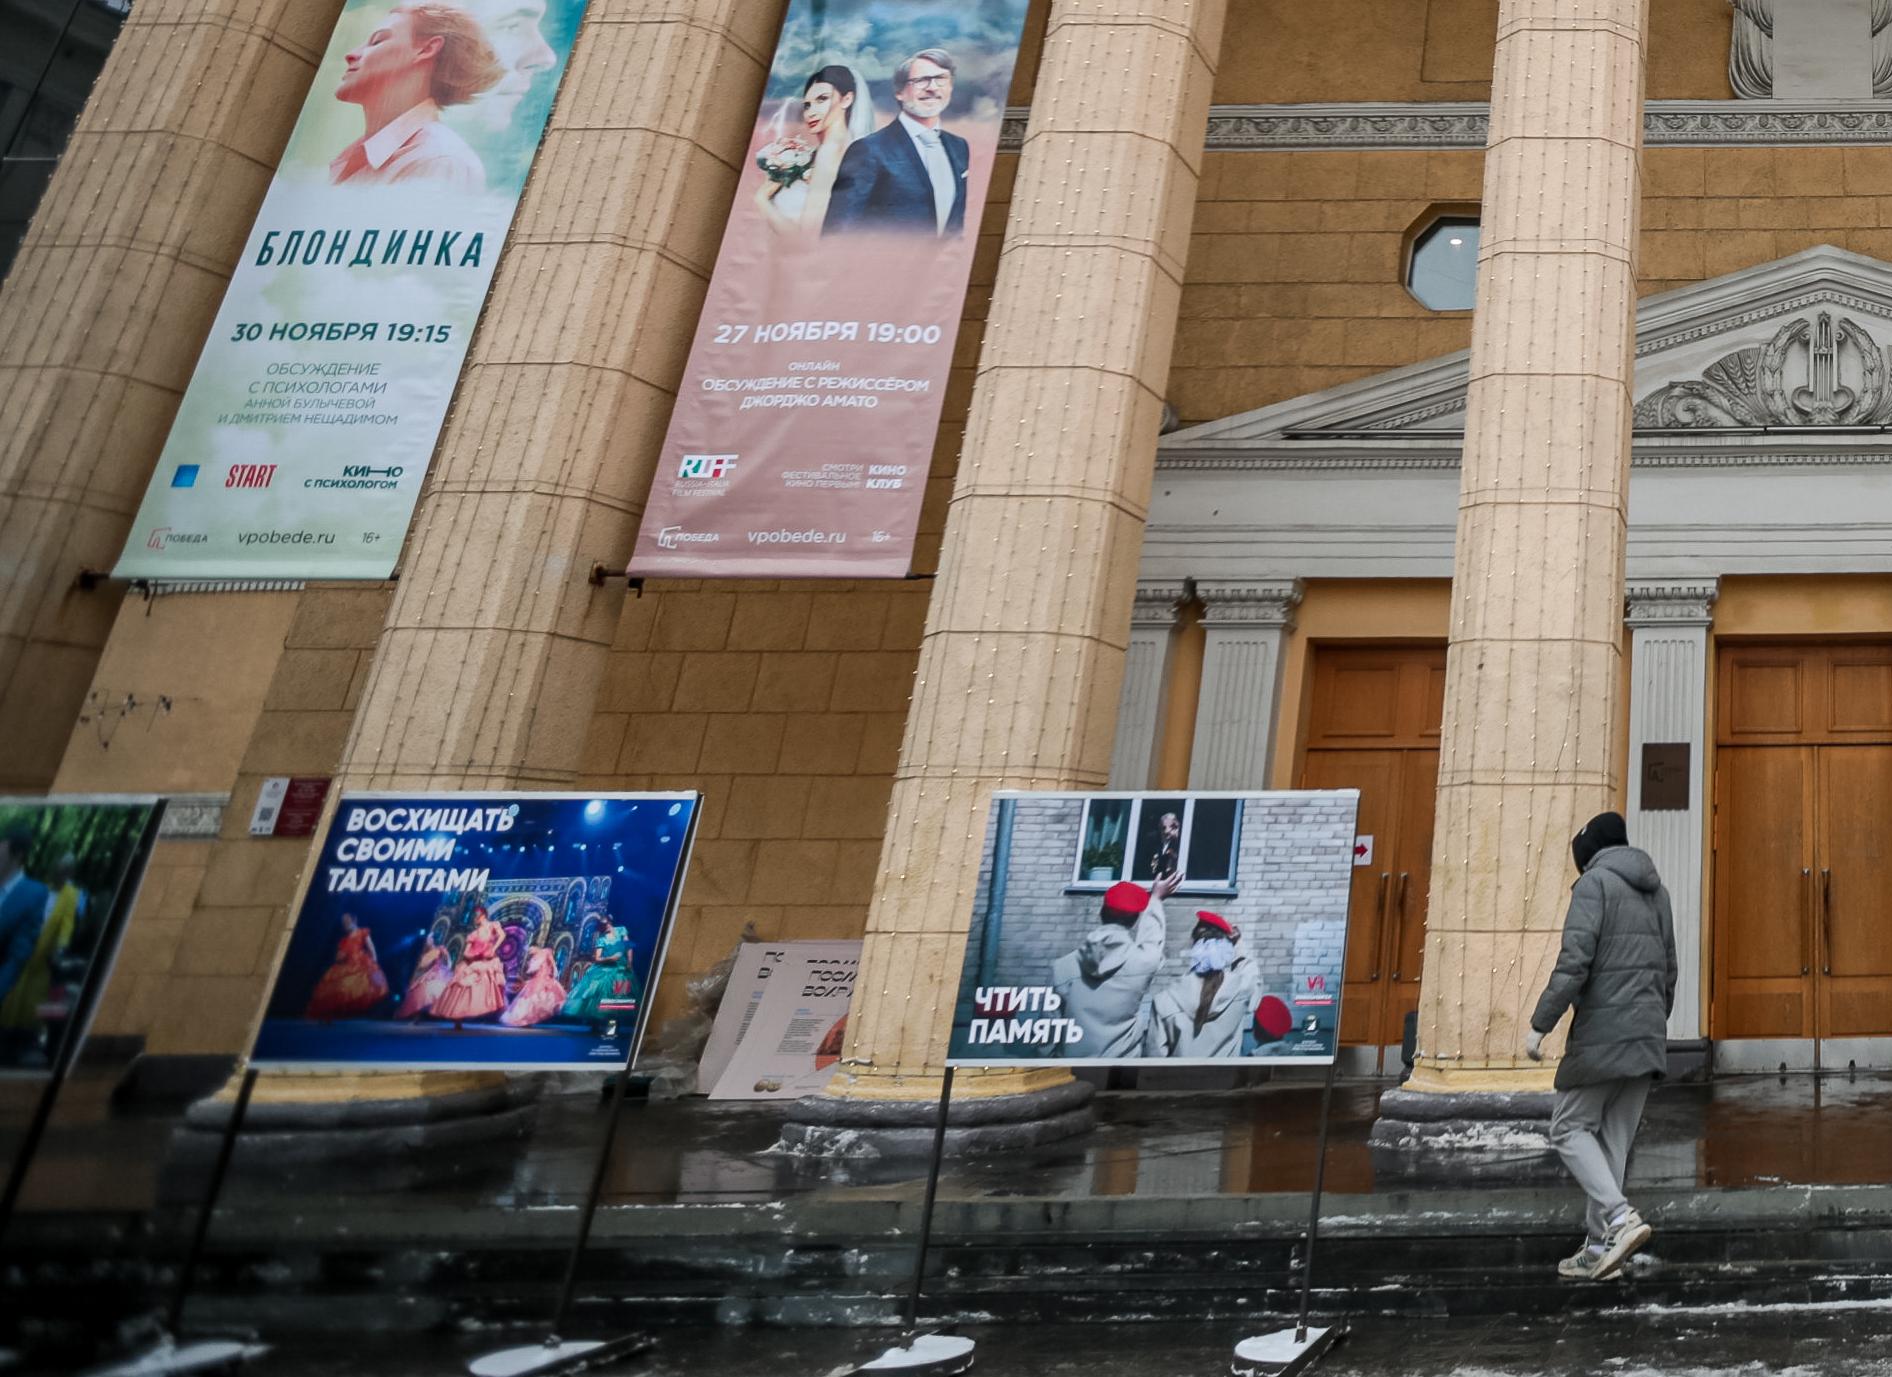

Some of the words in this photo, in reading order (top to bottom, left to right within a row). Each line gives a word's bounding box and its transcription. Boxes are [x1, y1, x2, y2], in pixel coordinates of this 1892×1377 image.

[255, 229, 486, 268] БЛОНДИНКА
[231, 323, 262, 342] 30
[268, 322, 378, 342] НОЯБРЯ
[386, 323, 452, 343] 19:15
[713, 325, 750, 344] 27
[754, 321, 859, 344] НОЯБРЯ
[866, 322, 941, 344] 19:00
[266, 363, 382, 377] ОБСУЖДЕНИЕ
[788, 360, 841, 371] ОНЛАЙН
[248, 381, 260, 394] С
[262, 381, 388, 395] ПСИХОЛОГАМИ
[702, 377, 802, 392] ОБСУЖДЕНИЕ
[804, 377, 817, 389] С
[245, 397, 291, 409] АННОЙ
[293, 397, 376, 409] БУЛЫЧЕВОЙ
[739, 395, 819, 410] ДЖОРДЖО
[822, 395, 878, 408] АМАТО
[217, 414, 229, 424] И
[229, 414, 302, 425] ДМИТРИЕМ
[225, 464, 278, 488] START
[868, 465, 907, 475] КИНО
[865, 479, 903, 489] КЛУБ
[165, 534, 208, 544] ПОБЕДА
[238, 528, 335, 545] vpobede.ru
[362, 532, 381, 543] 16+
[675, 532, 720, 542] ПОБЕДА
[748, 528, 846, 544] vpobede.ru
[871, 531, 890, 542] 16+
[346, 808, 515, 836] ВОСХИЩАТЬ
[336, 838, 455, 862] СВОИМИ
[327, 868, 489, 892] ТАЛАНТАМИ
[974, 986, 1061, 1012] ЧТИТЬ
[968, 1018, 1083, 1044] ПАМЯТЬ
